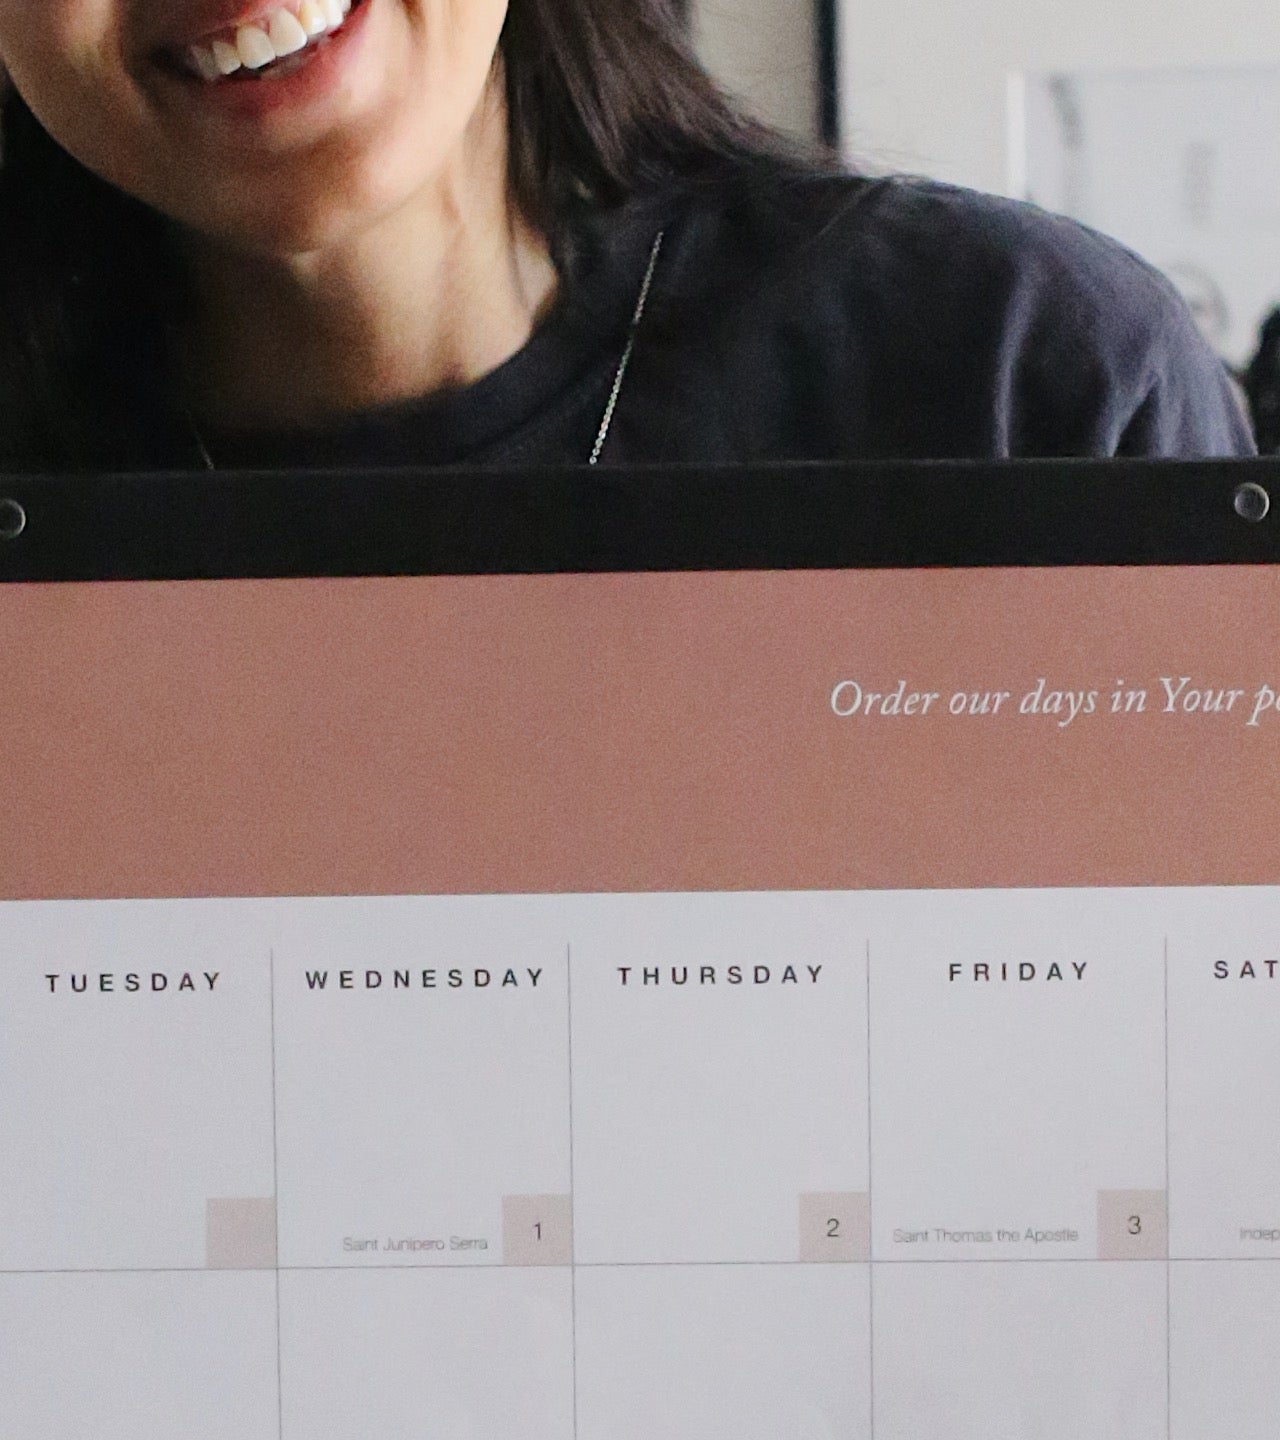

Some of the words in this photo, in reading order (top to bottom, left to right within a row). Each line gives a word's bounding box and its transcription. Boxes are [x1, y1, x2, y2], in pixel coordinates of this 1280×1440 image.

[830, 680, 940, 717] Order
[949, 691, 1011, 715] our
[1019, 678, 1099, 728] days
[1111, 679, 1147, 713] in
[1159, 676, 1245, 713] Your
[305, 968, 542, 990] WEDNESDAY
[617, 964, 822, 986] THURSDAY
[949, 961, 1087, 982] FRIDAY
[44, 972, 219, 993] TUESDAY
[533, 1222, 542, 1241] 1
[826, 1217, 841, 1238] 2
[893, 1228, 929, 1244] Saint
[934, 1228, 993, 1244] Thomas
[996, 1229, 1021, 1242] the
[1023, 1227, 1079, 1245] Apostle
[1128, 1215, 1142, 1236] 3
[342, 1236, 379, 1252] Saint
[383, 1237, 446, 1254] Junipero
[449, 1235, 489, 1251] Serra
